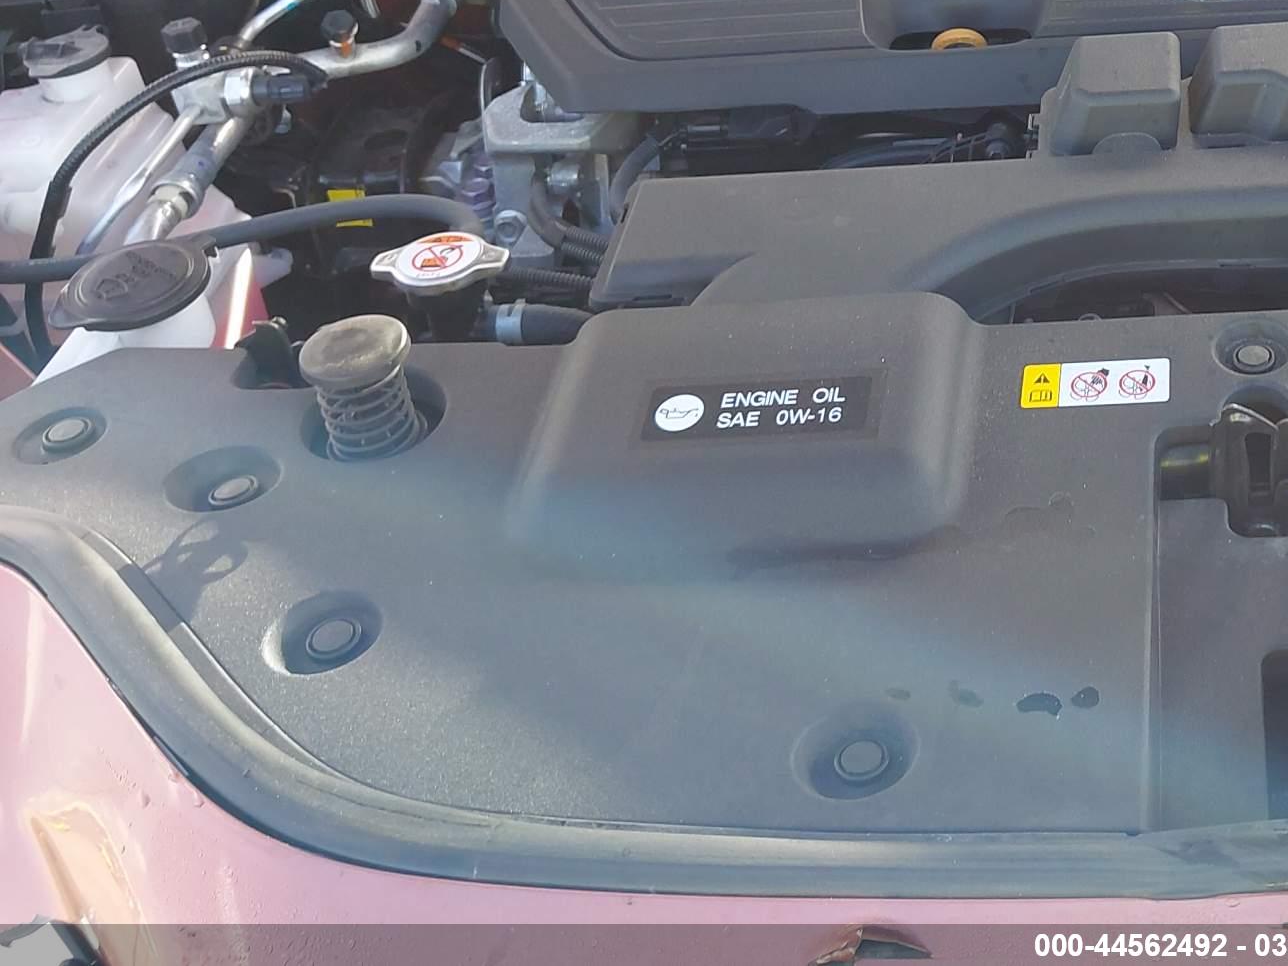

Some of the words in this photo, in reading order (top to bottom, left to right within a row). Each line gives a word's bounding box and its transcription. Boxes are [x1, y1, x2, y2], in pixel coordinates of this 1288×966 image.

[720, 388, 800, 409] ENGINE
[812, 386, 846, 404] OIL
[716, 410, 761, 429] SAE
[775, 406, 843, 427] 0W-16
